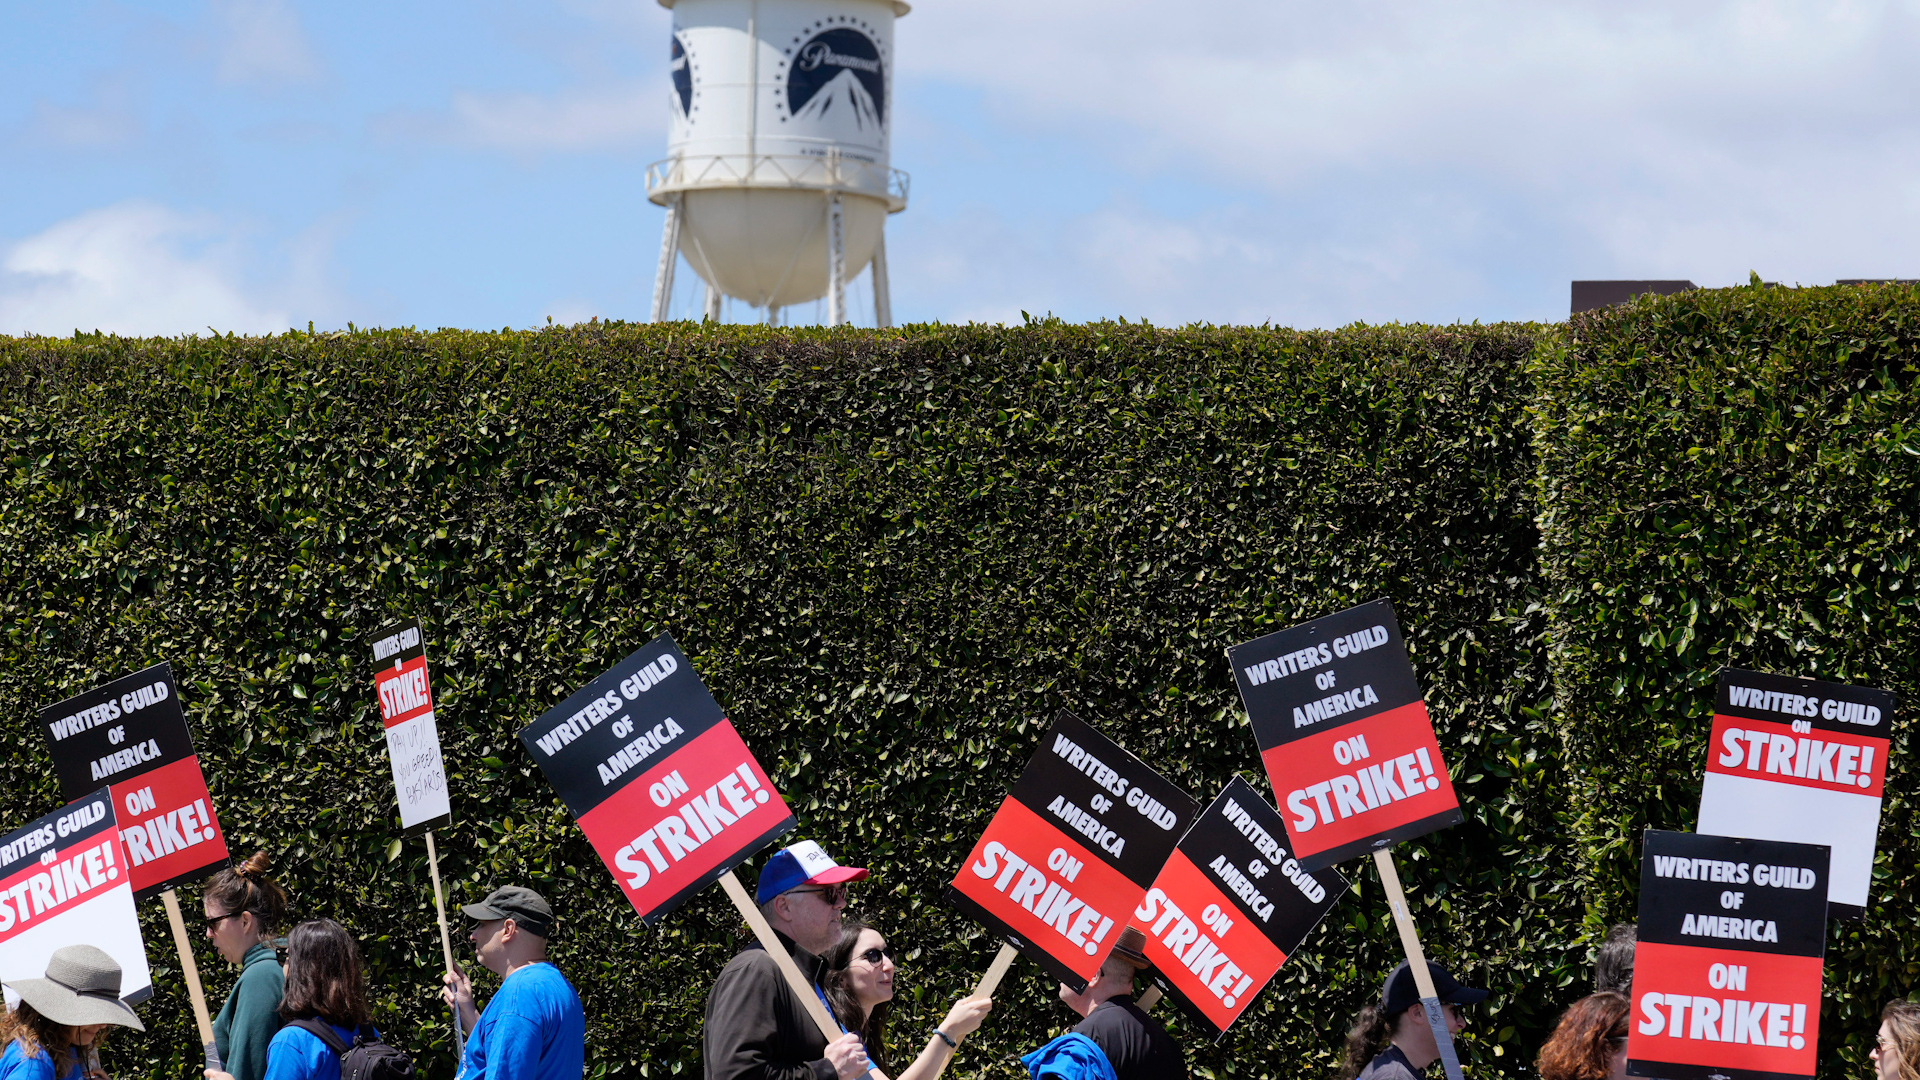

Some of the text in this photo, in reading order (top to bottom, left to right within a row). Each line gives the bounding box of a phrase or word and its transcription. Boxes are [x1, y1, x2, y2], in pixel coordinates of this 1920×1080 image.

[800, 41, 880, 73] Paramount
[373, 626, 420, 661] WRITERS GUILD
[1244, 625, 1389, 687] WRITERS GUILD
[380, 667, 428, 720] STRIKE!
[1315, 670, 1336, 690] OF
[50, 682, 168, 742] WRITERS GUILD
[536, 653, 678, 757] WRITERS GUILD
[1292, 684, 1380, 728] AMERICA
[1728, 685, 1882, 727] WRITERS GUILD
[108, 725, 124, 746] OF
[391, 733, 406, 755] PAY
[612, 714, 634, 739] OF
[1791, 719, 1812, 734] ON
[90, 738, 162, 781] AMERICA
[596, 717, 684, 786] AMERICA
[1333, 734, 1370, 766] ON
[1718, 728, 1875, 788] STRIKE!
[398, 763, 411, 785] YOU
[649, 770, 690, 808] ON
[1052, 733, 1177, 831] WRITERS GUILD
[1286, 746, 1440, 833] STRIKE!
[126, 786, 156, 816] ON
[1090, 793, 1112, 815] OF
[0, 800, 106, 868] RITERS GUILD
[118, 798, 215, 870] RIKE!
[614, 762, 770, 890] STRIKE!
[1047, 794, 1126, 859] AMERICA
[40, 848, 58, 866] ON
[1048, 847, 1084, 882] ON
[1221, 798, 1326, 904] WRITERS GUILD
[1248, 858, 1270, 880] OF
[0, 840, 118, 932] STRIKE!
[1210, 854, 1276, 923] AMERICA
[1654, 855, 1816, 890] WRITERS GUILD
[972, 840, 1114, 956] STRIKE!
[1720, 891, 1744, 910] OF
[1202, 904, 1234, 938] ON
[1680, 914, 1778, 944] AMERICA
[1134, 887, 1254, 1009] STRIKE!
[1708, 964, 1748, 992] ON
[1638, 992, 1806, 1050] STRIKE!
